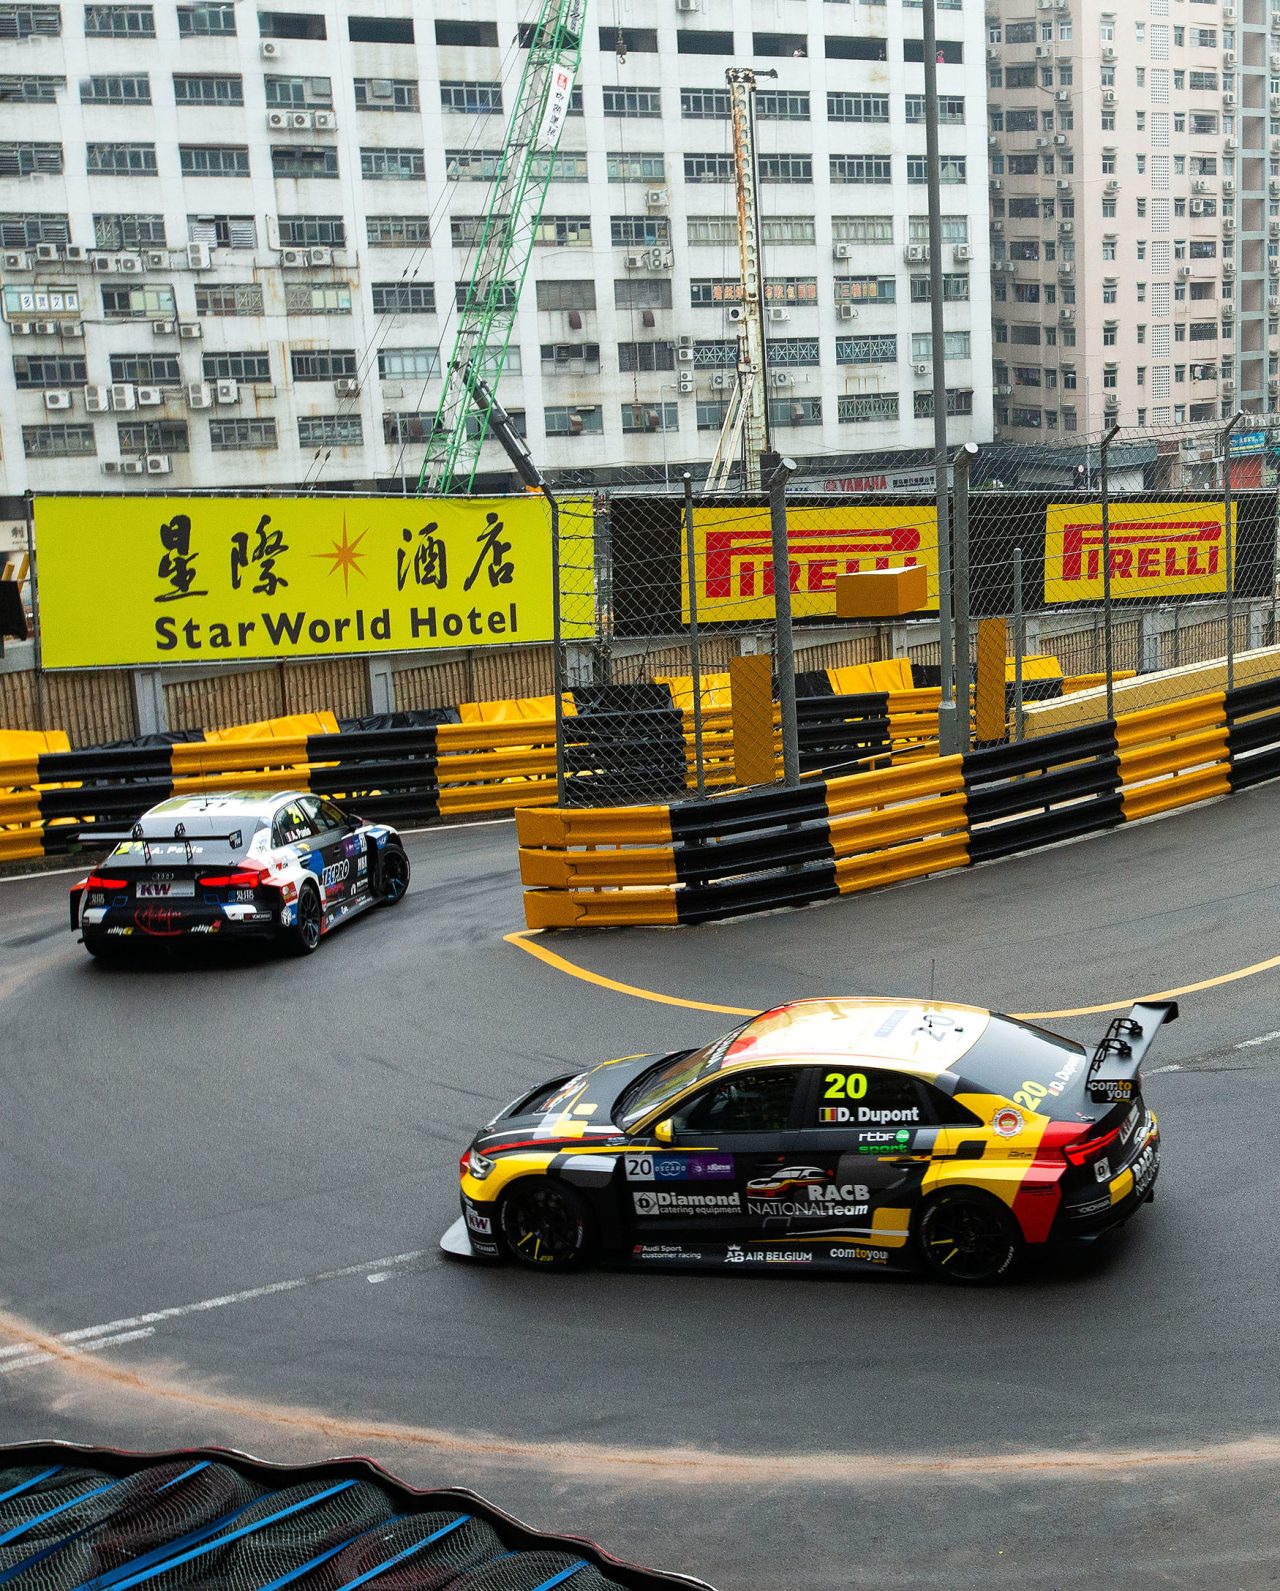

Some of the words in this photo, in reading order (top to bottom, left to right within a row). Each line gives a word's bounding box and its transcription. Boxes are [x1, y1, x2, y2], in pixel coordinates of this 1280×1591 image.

[838, 475, 887, 492] YAMAHA
[1062, 521, 1221, 582] PIRELLI
[706, 528, 921, 599] PIRE
[411, 602, 518, 638] Hotel
[140, 883, 171, 896] KW
[823, 1072, 868, 1099] 20
[1013, 1080, 1048, 1111] 20
[1106, 1090, 1132, 1101] you
[837, 1107, 855, 1122] D.
[858, 1106, 920, 1125] Dupont
[858, 1143, 908, 1155] sport
[628, 1159, 652, 1176] 20
[657, 1192, 740, 1206] Diamond
[807, 1184, 870, 1201] RACB
[660, 1206, 694, 1215] catering
[696, 1206, 742, 1215] equipment
[661, 1245, 682, 1253] Sport
[678, 1252, 701, 1260] racing
[745, 1251, 764, 1261] AIR
[766, 1251, 813, 1261] BELGIUM
[830, 1247, 889, 1261] comtoyou
